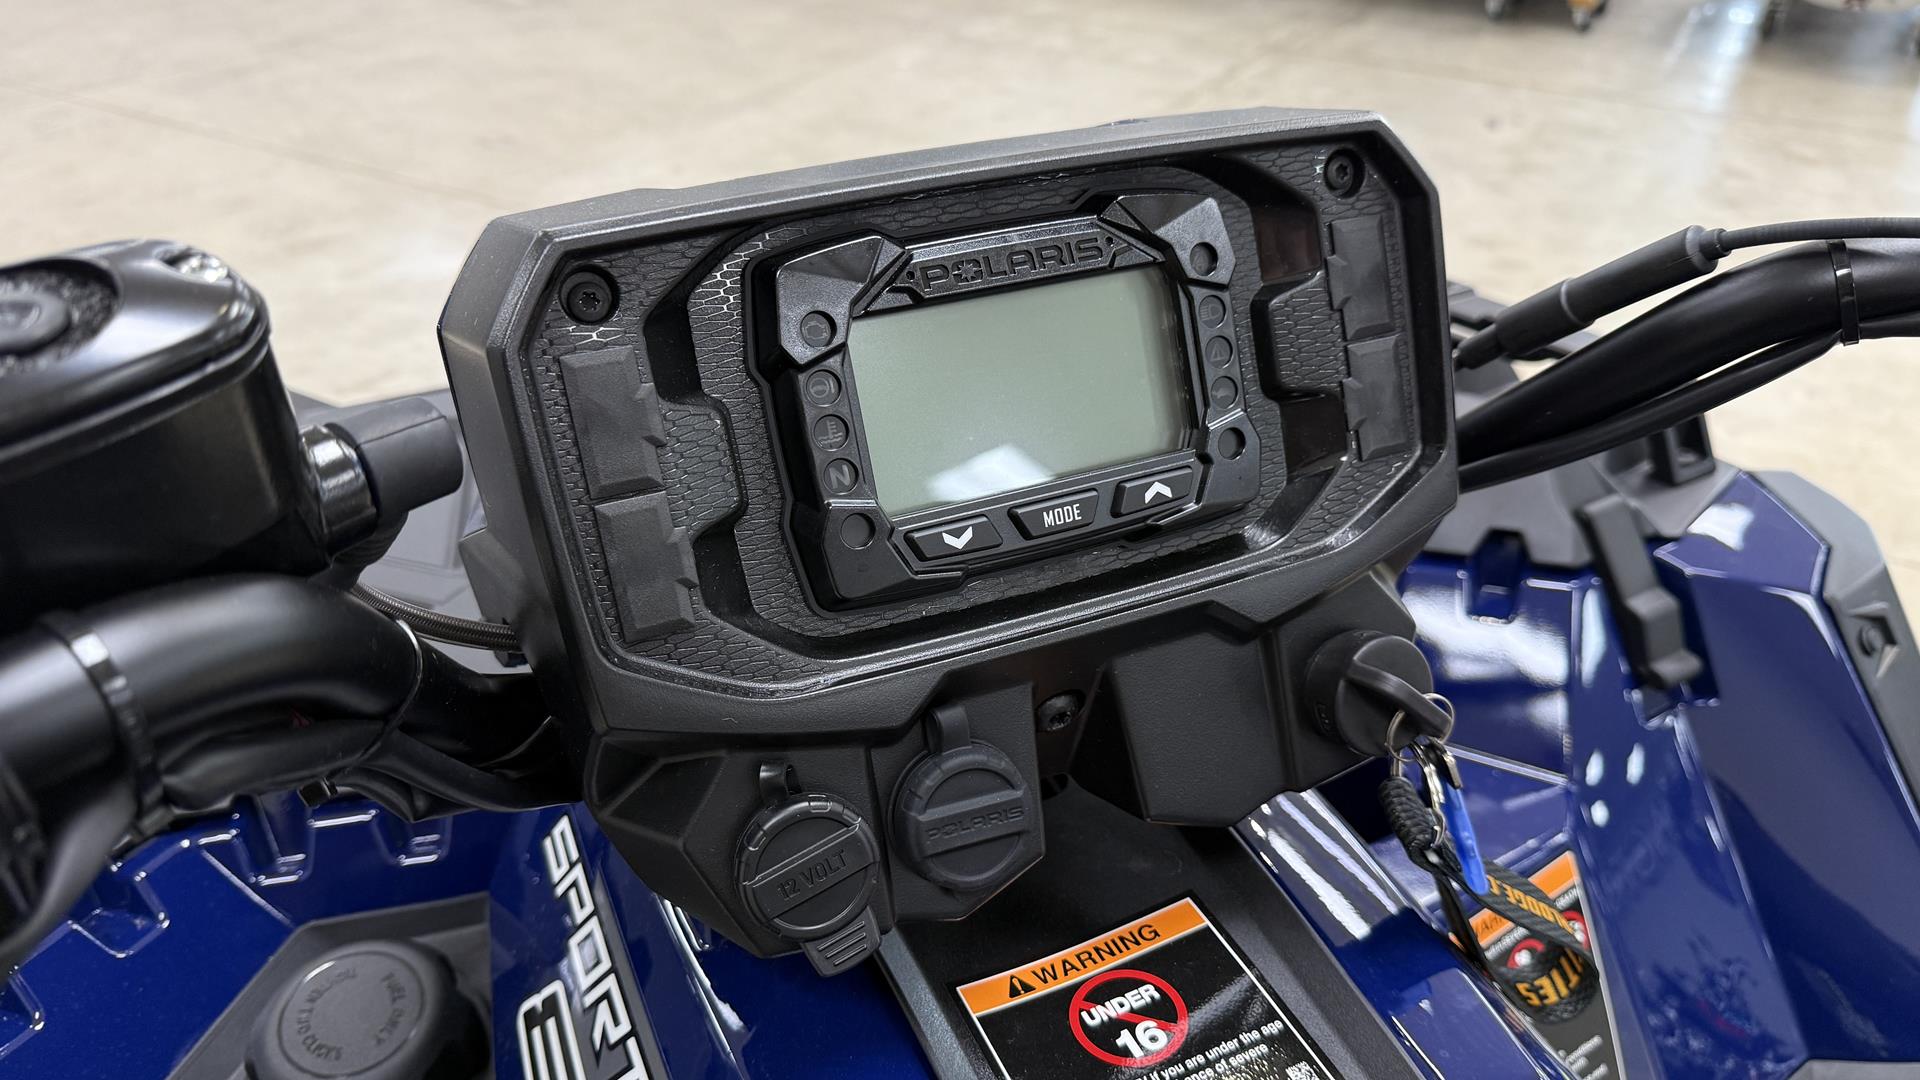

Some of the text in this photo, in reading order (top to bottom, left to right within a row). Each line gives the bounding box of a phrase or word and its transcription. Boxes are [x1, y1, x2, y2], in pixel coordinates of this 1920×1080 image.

[922, 237, 1104, 291] POLARIS
[1042, 503, 1083, 528] MODE
[924, 805, 1025, 840] POLARIS
[777, 849, 848, 901] 12 VOLT
[1032, 924, 1161, 986] WARNING
[1079, 983, 1162, 1029] UNDER
[1115, 1020, 1169, 1060] 16
[1160, 1063, 1186, 1080] you
[1184, 1054, 1206, 1071] are
[1204, 1038, 1241, 1062] under
[1238, 1029, 1263, 1047] the
[1260, 1019, 1285, 1037] age
[1214, 1058, 1230, 1075] of
[1228, 1043, 1270, 1068] severe
